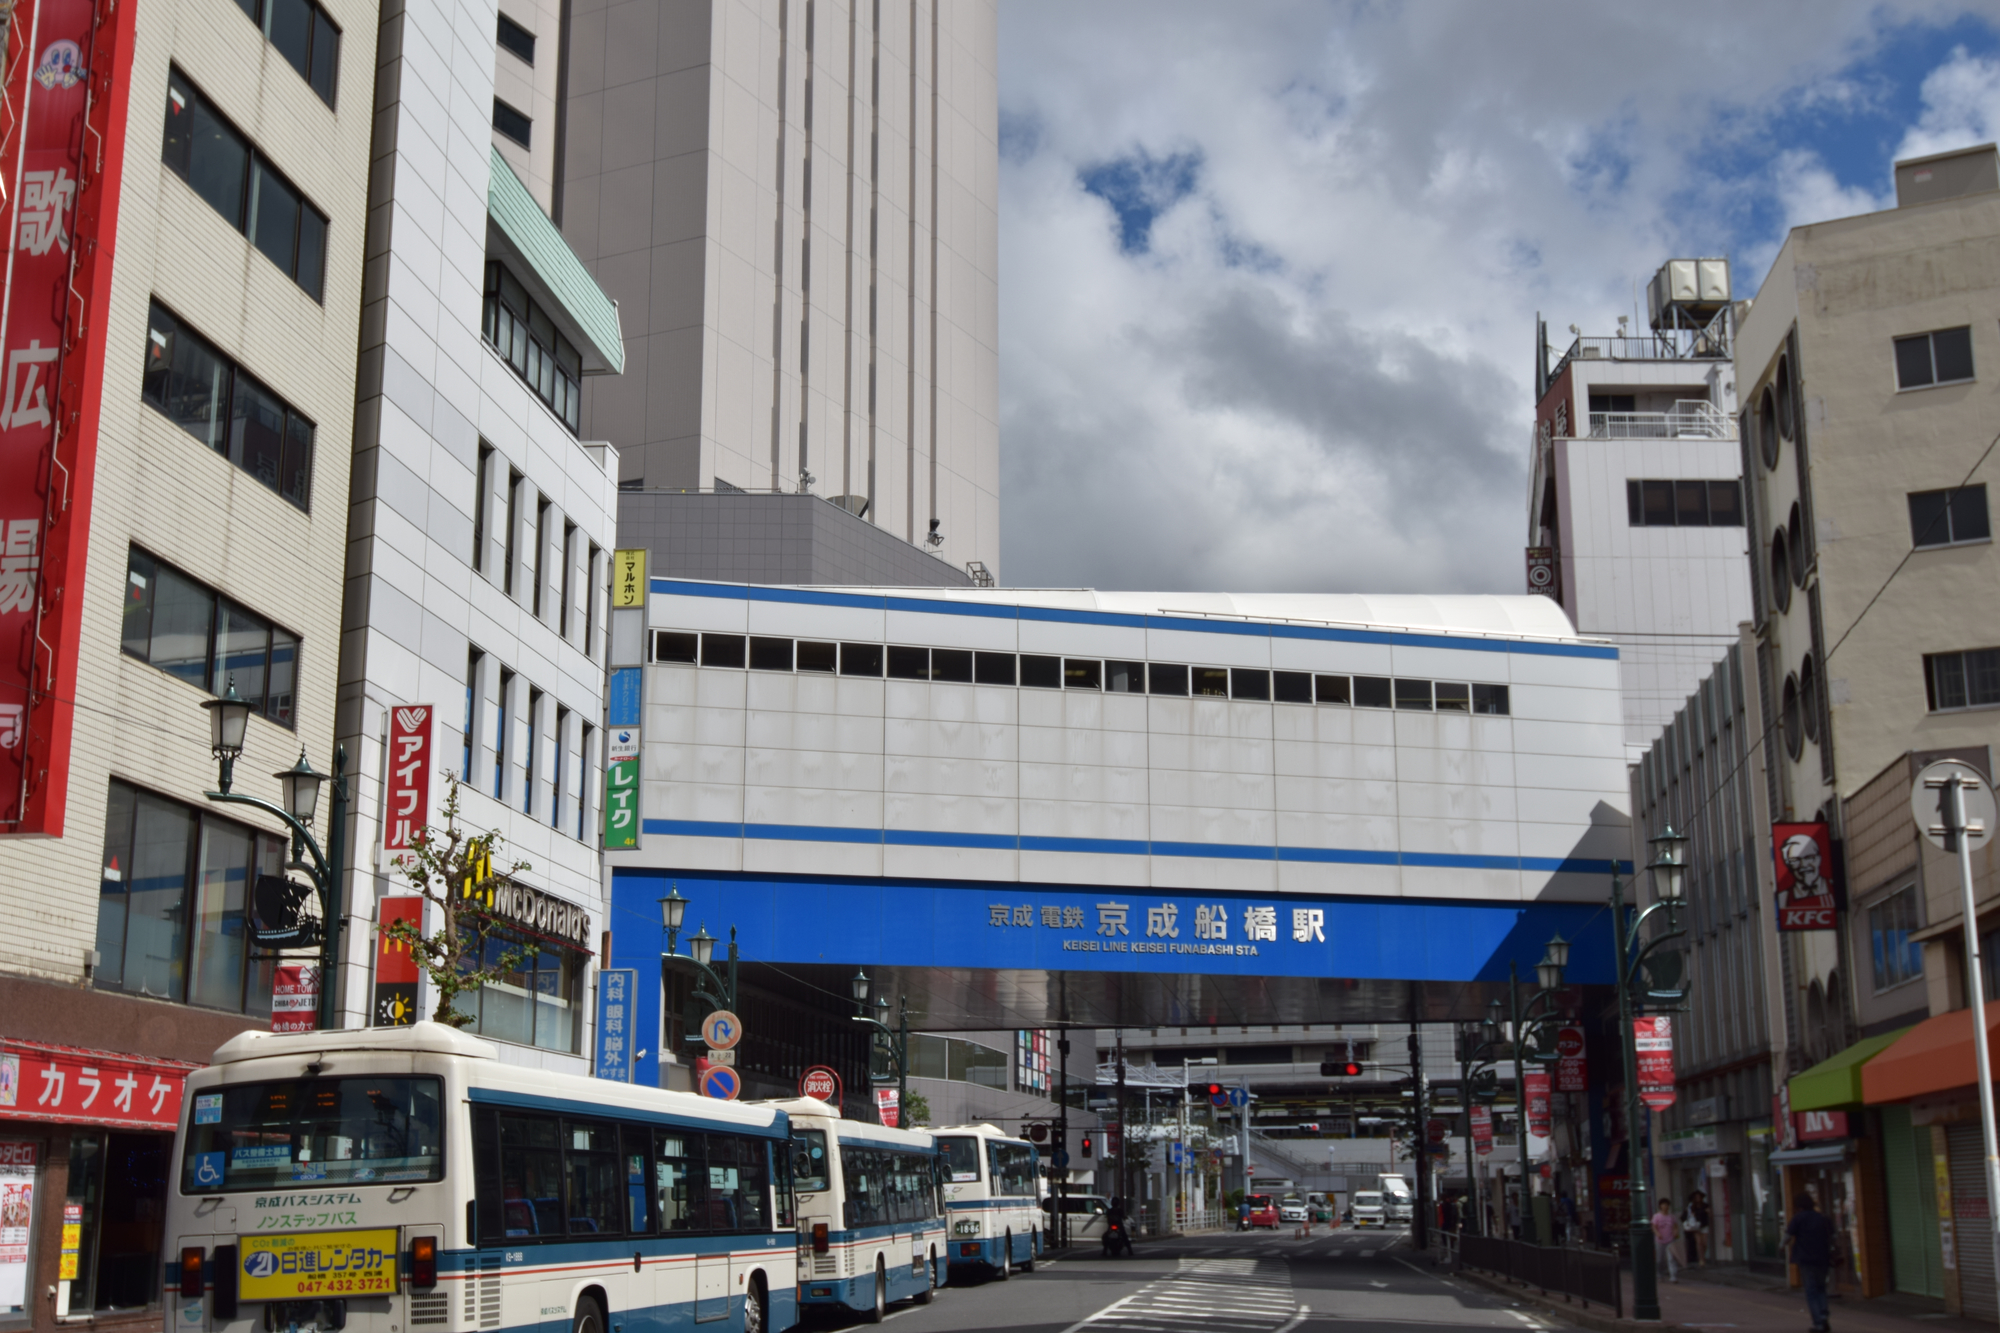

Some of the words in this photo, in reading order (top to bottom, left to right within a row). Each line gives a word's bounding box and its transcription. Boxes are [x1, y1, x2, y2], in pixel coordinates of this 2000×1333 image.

[624, 562, 635, 605] マルホン
[391, 736, 423, 847] アイフル
[611, 766, 633, 829] レイク
[624, 837, 635, 846] 4F
[494, 881, 591, 944] McDonald's
[1785, 910, 1833, 926] KFC
[988, 903, 1034, 928] 京成
[1040, 905, 1084, 929] 電鉄
[1096, 901, 1326, 943] 京成船橋駅
[1063, 940, 1100, 951] KEISEI
[1103, 941, 1128, 952] LINE
[1131, 942, 1167, 953] KEISEI
[1169, 943, 1234, 955] FUNABASHI
[275, 984, 295, 994] HOME
[297, 984, 318, 994] TOWN
[606, 972, 624, 1002] 内科
[298, 998, 316, 1007] JETS
[600, 1067, 626, 1078] やすま
[38, 1062, 171, 1115] カラオケ
[807, 1080, 832, 1093] 消火栓
[0, 1145, 32, 1164] タヒロ
[255, 1193, 362, 1208] 京成バスシステム
[256, 1211, 357, 1229] ノンステップバス
[281, 1247, 396, 1274] 日進レンタカー
